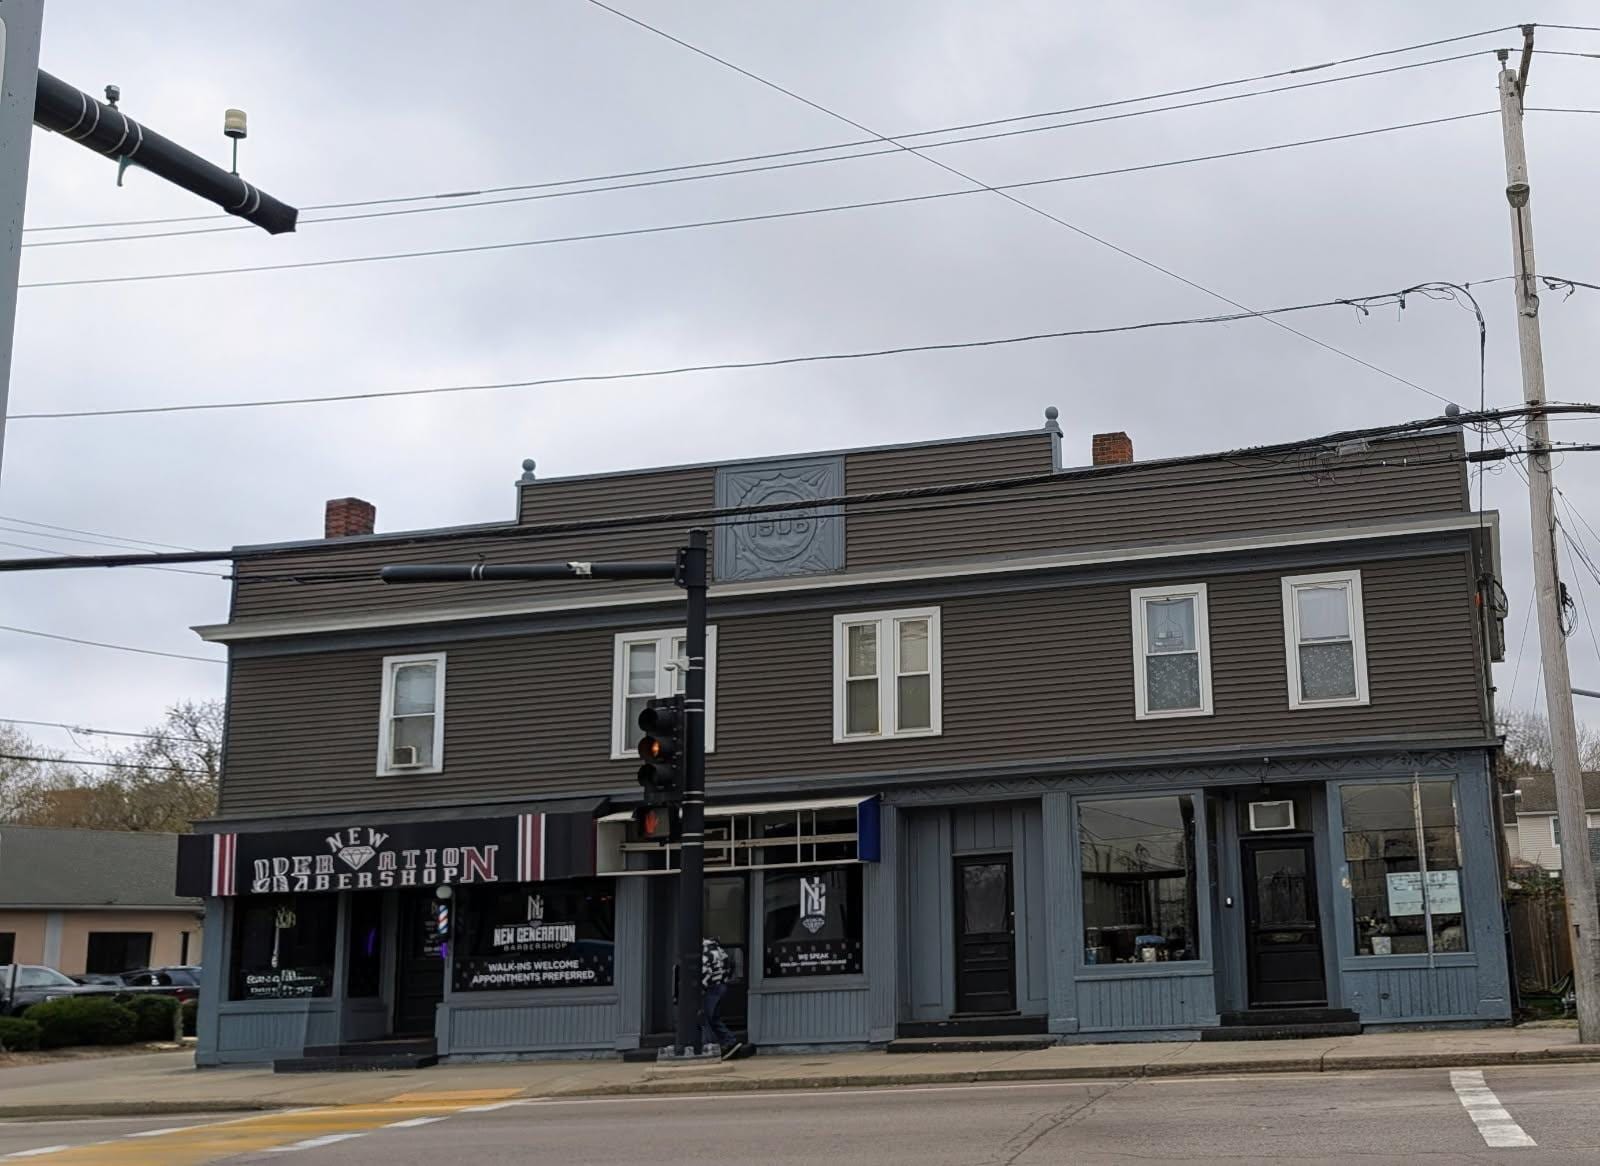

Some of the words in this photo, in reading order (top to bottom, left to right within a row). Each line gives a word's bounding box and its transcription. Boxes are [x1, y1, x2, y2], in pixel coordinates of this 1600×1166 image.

[325, 827, 390, 853] NEW
[251, 868, 458, 893] BERSHOP
[494, 928, 514, 946] NEW
[517, 925, 576, 943] GENERATION
[503, 943, 567, 952] BARBERSHOP
[488, 961, 532, 972] WALK-INS
[533, 959, 580, 971] WELCOME
[471, 971, 541, 984] APPOINTMENTS
[542, 970, 595, 981] PREFERRED
